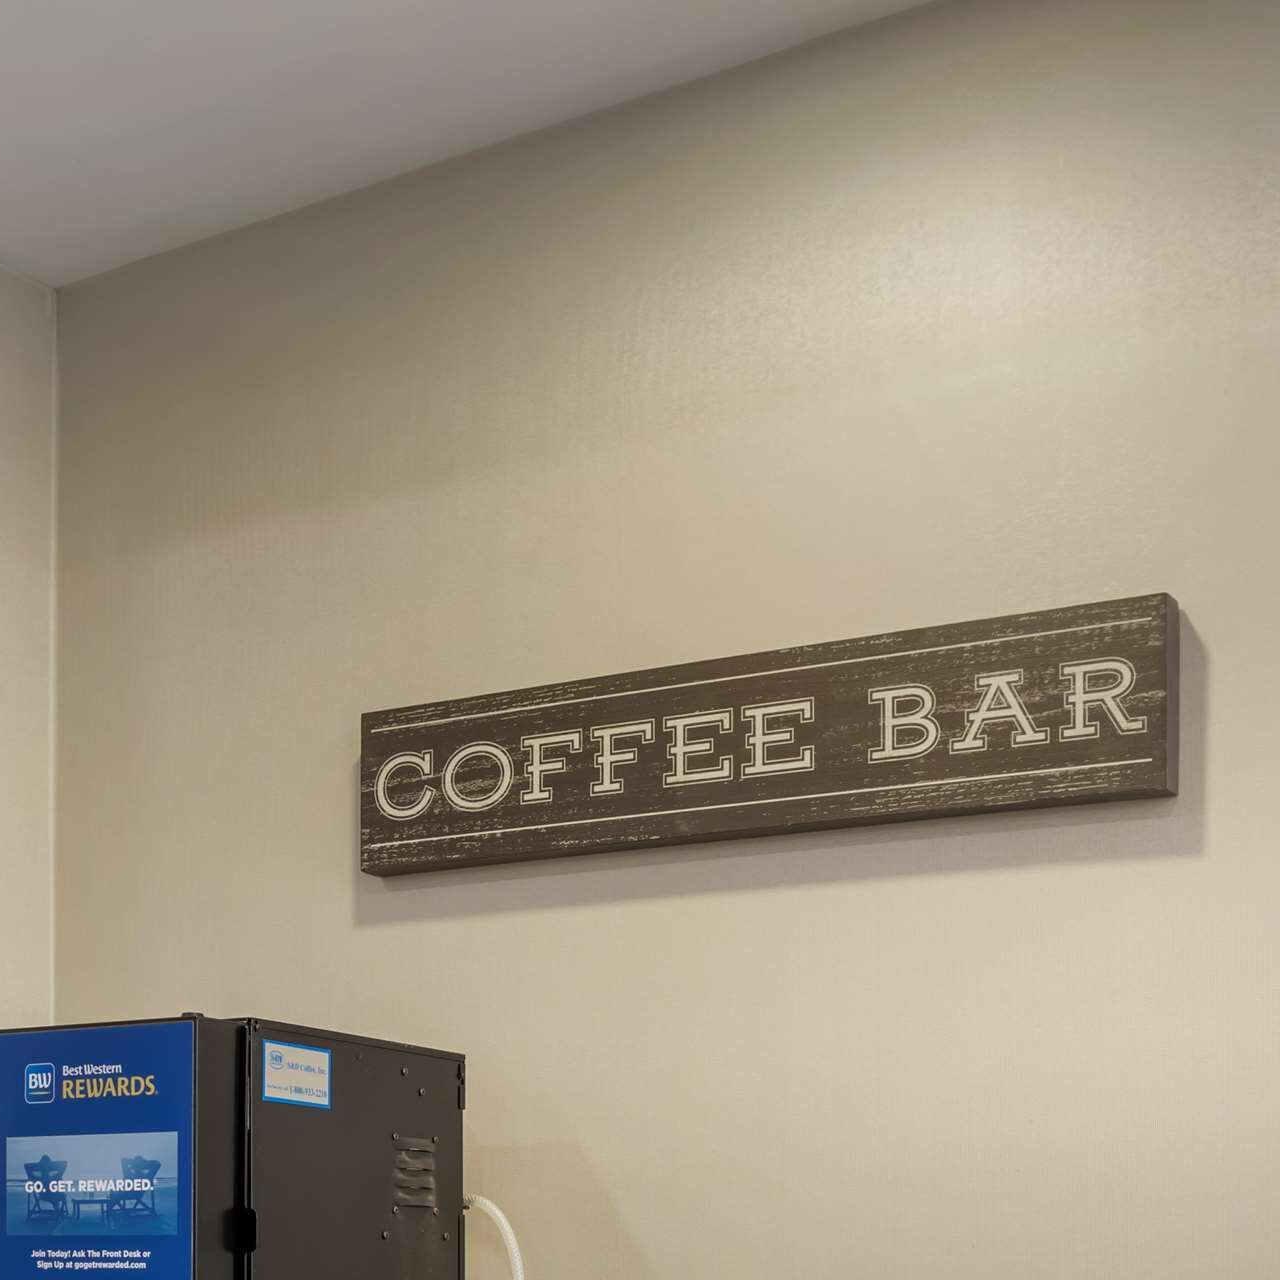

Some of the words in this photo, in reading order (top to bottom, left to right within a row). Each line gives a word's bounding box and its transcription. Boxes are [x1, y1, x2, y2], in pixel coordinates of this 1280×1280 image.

[373, 697, 815, 821] COFFEE
[868, 656, 1147, 764] BAR
[62, 1065, 83, 1076] Best
[84, 1064, 122, 1075] Western
[28, 1072, 52, 1089] BW
[25, 1181, 46, 1193] GO.
[49, 1180, 75, 1192] GET.
[31, 1250, 46, 1258] Join
[47, 1250, 71, 1259] Today!
[37, 1261, 53, 1270] Sign
[54, 1261, 64, 1269] Up
[74, 1261, 147, 1269] gogetrewarded.com
